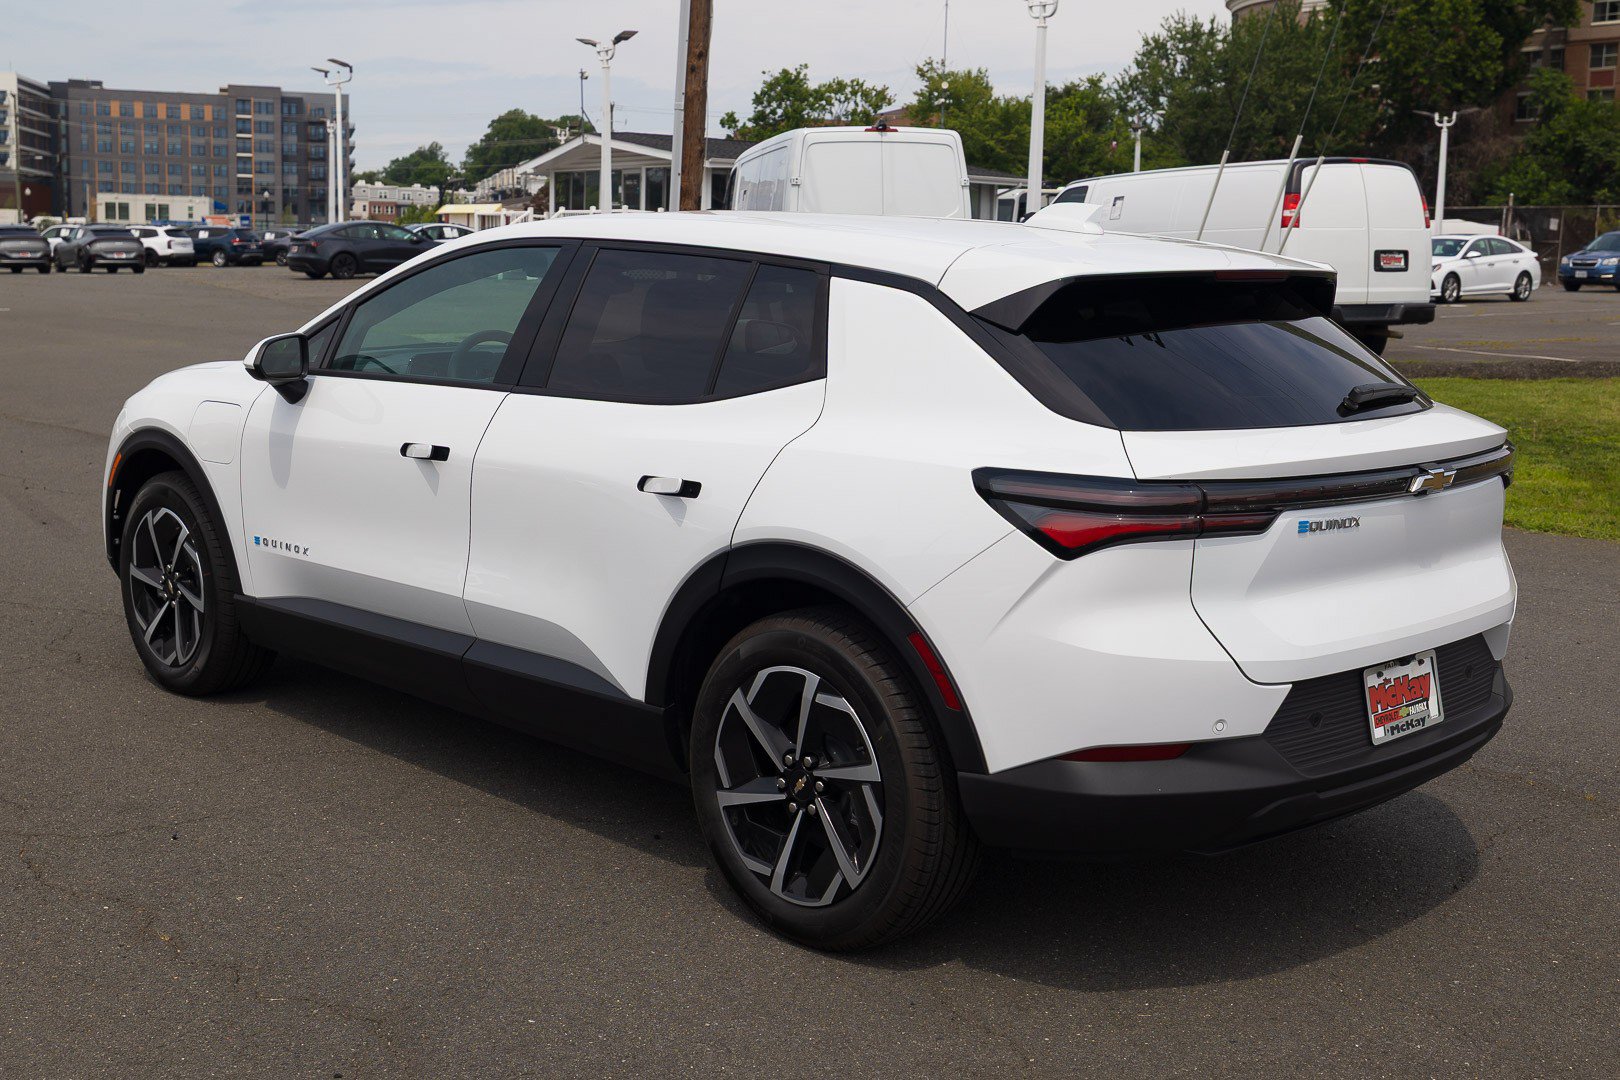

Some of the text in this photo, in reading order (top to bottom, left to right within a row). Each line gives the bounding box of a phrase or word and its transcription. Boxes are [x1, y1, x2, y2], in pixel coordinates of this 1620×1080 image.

[1298, 516, 1360, 533] EQUINOX
[254, 536, 309, 556] EQUINOX
[1368, 672, 1430, 714] McKay
